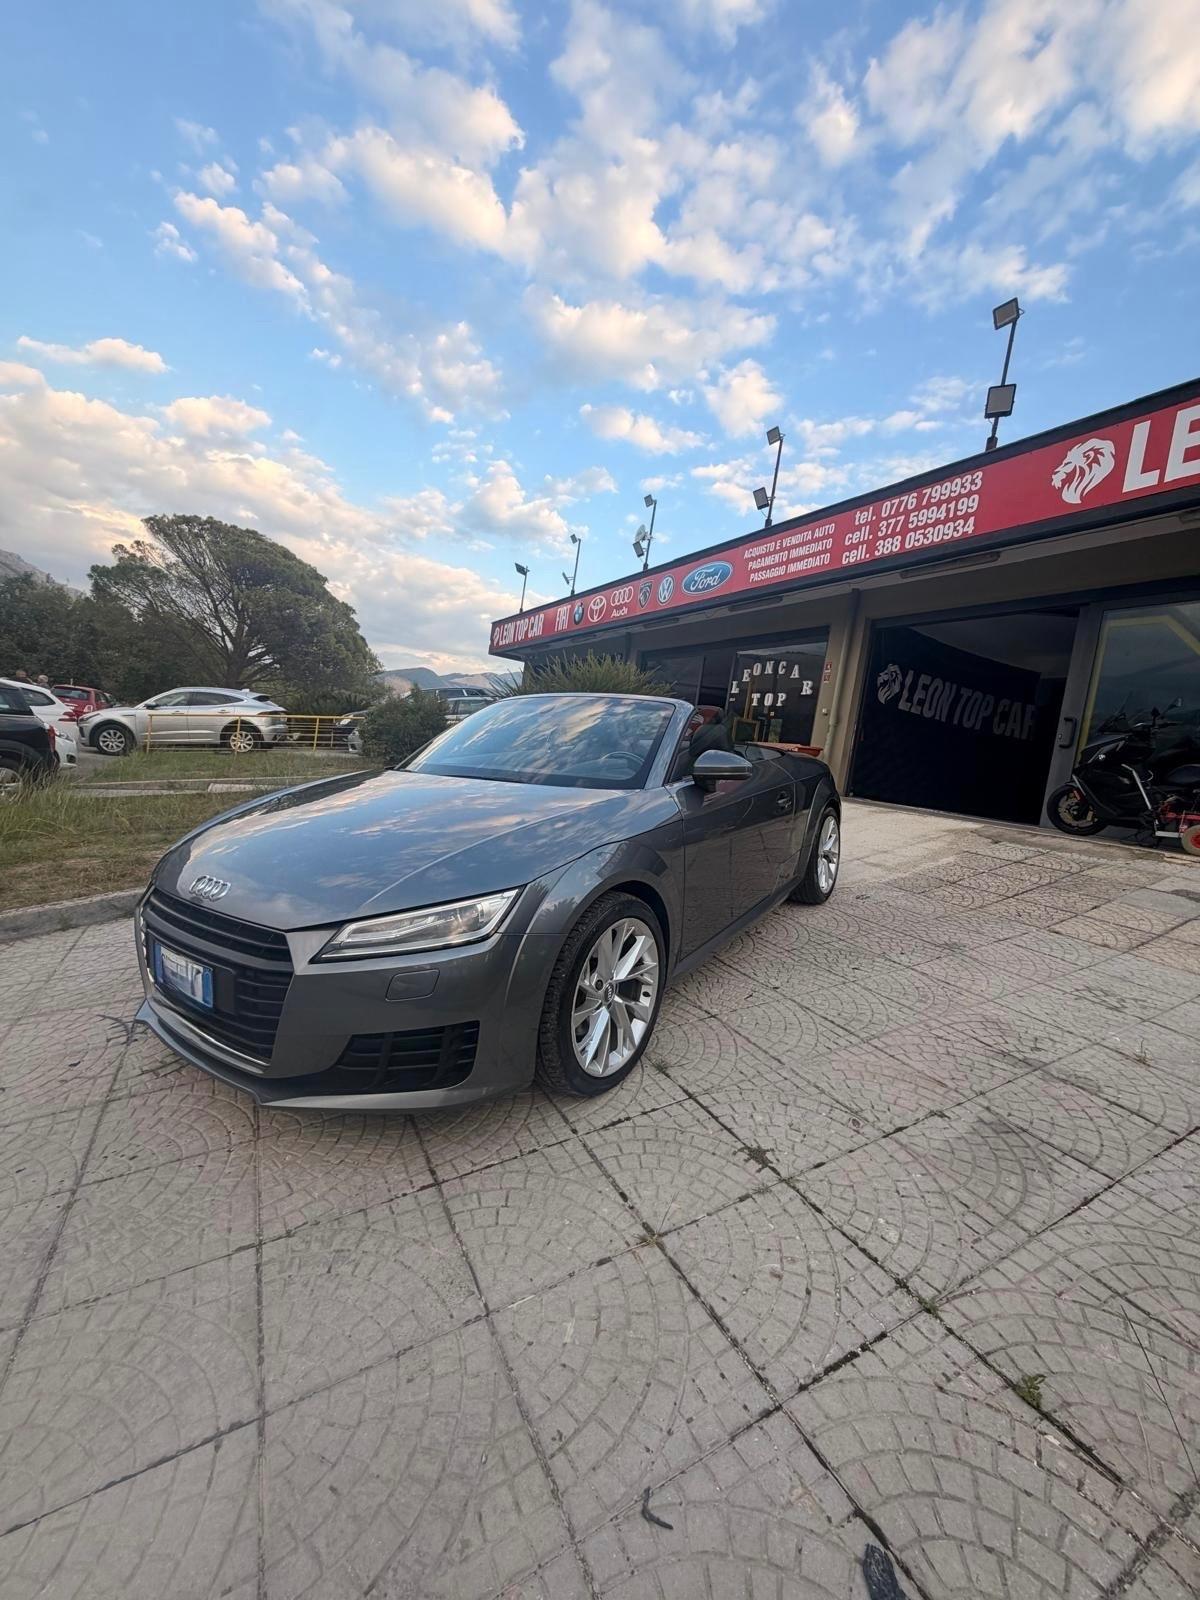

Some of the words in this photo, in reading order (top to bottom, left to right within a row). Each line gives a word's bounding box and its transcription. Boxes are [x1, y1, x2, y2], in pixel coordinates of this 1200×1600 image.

[855, 506, 876, 525] tel.
[881, 495, 917, 517] 0776
[922, 471, 983, 505] 799933
[845, 525, 873, 546] cell.
[877, 514, 903, 537] 377
[908, 494, 979, 529] 5994199
[744, 541, 775, 559] ACQUISTO
[776, 540, 781, 550] E
[782, 531, 812, 548] VENDITA
[812, 523, 835, 540] AUTO
[748, 552, 788, 571] PAGAMENTO
[789, 538, 833, 559] IMMEDIATO
[842, 545, 870, 565] cell.
[874, 536, 901, 557] 388
[904, 516, 975, 549] 0530934
[690, 568, 722, 591] Ford
[749, 565, 786, 582] PASSAGGIO
[787, 553, 830, 574] IMMEDIATO
[499, 620, 516, 646] LEON
[515, 618, 529, 642] TOP
[528, 613, 545, 638] CAR
[555, 605, 571, 632] FIAT
[611, 608, 628, 618] Audi
[751, 693, 787, 706] TOP
[898, 669, 957, 723] LEON
[953, 686, 995, 731] TOP
